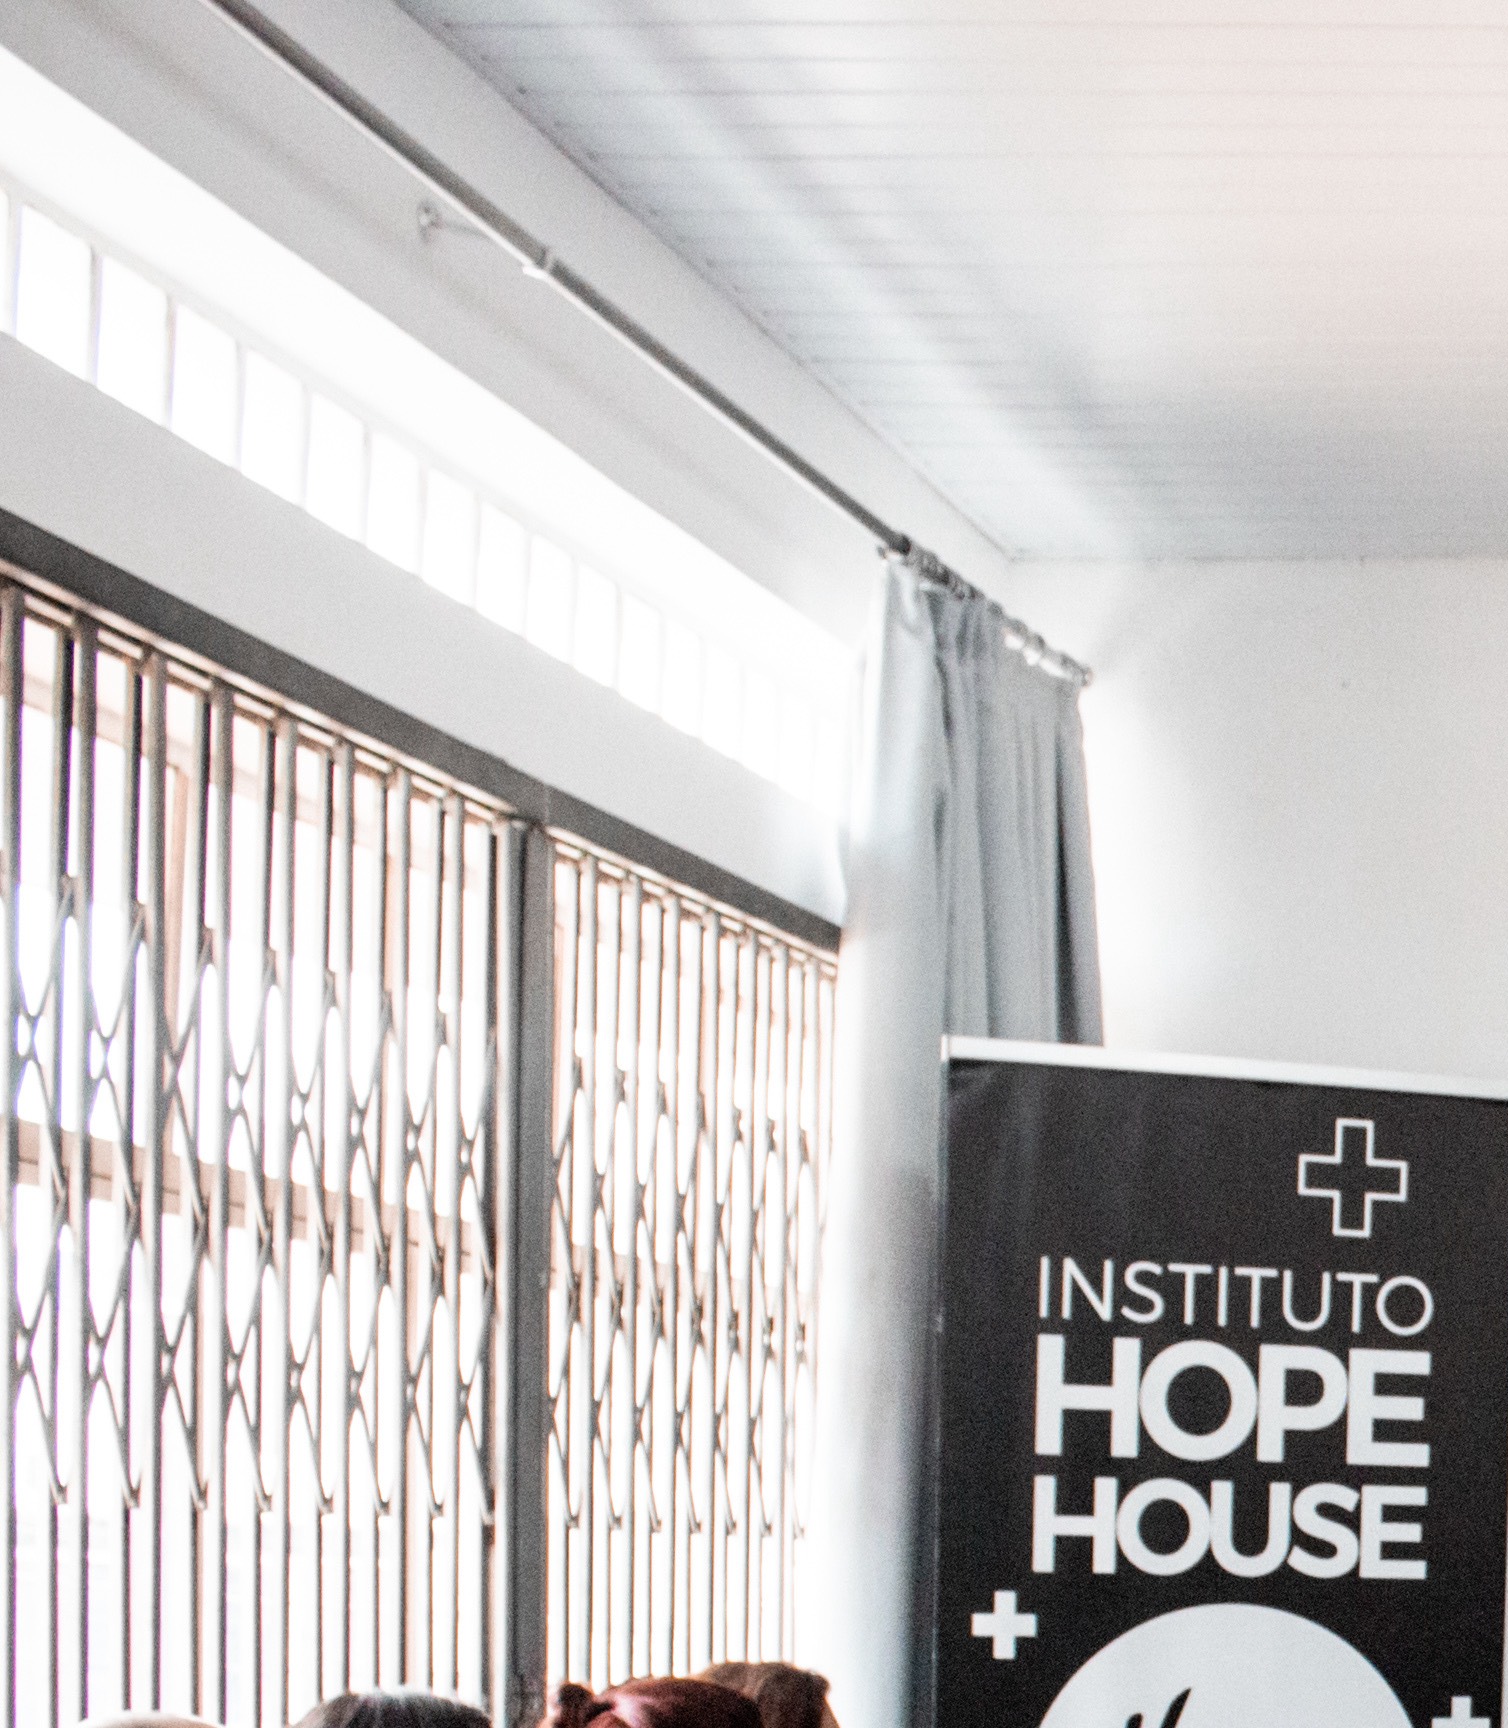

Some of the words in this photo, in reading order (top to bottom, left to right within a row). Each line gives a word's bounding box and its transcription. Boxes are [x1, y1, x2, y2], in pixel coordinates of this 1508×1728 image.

[1037, 1255, 1434, 1336] INSTITUTO
[1034, 1333, 1431, 1468] HOPE
[1032, 1474, 1428, 1580] HOUSE
